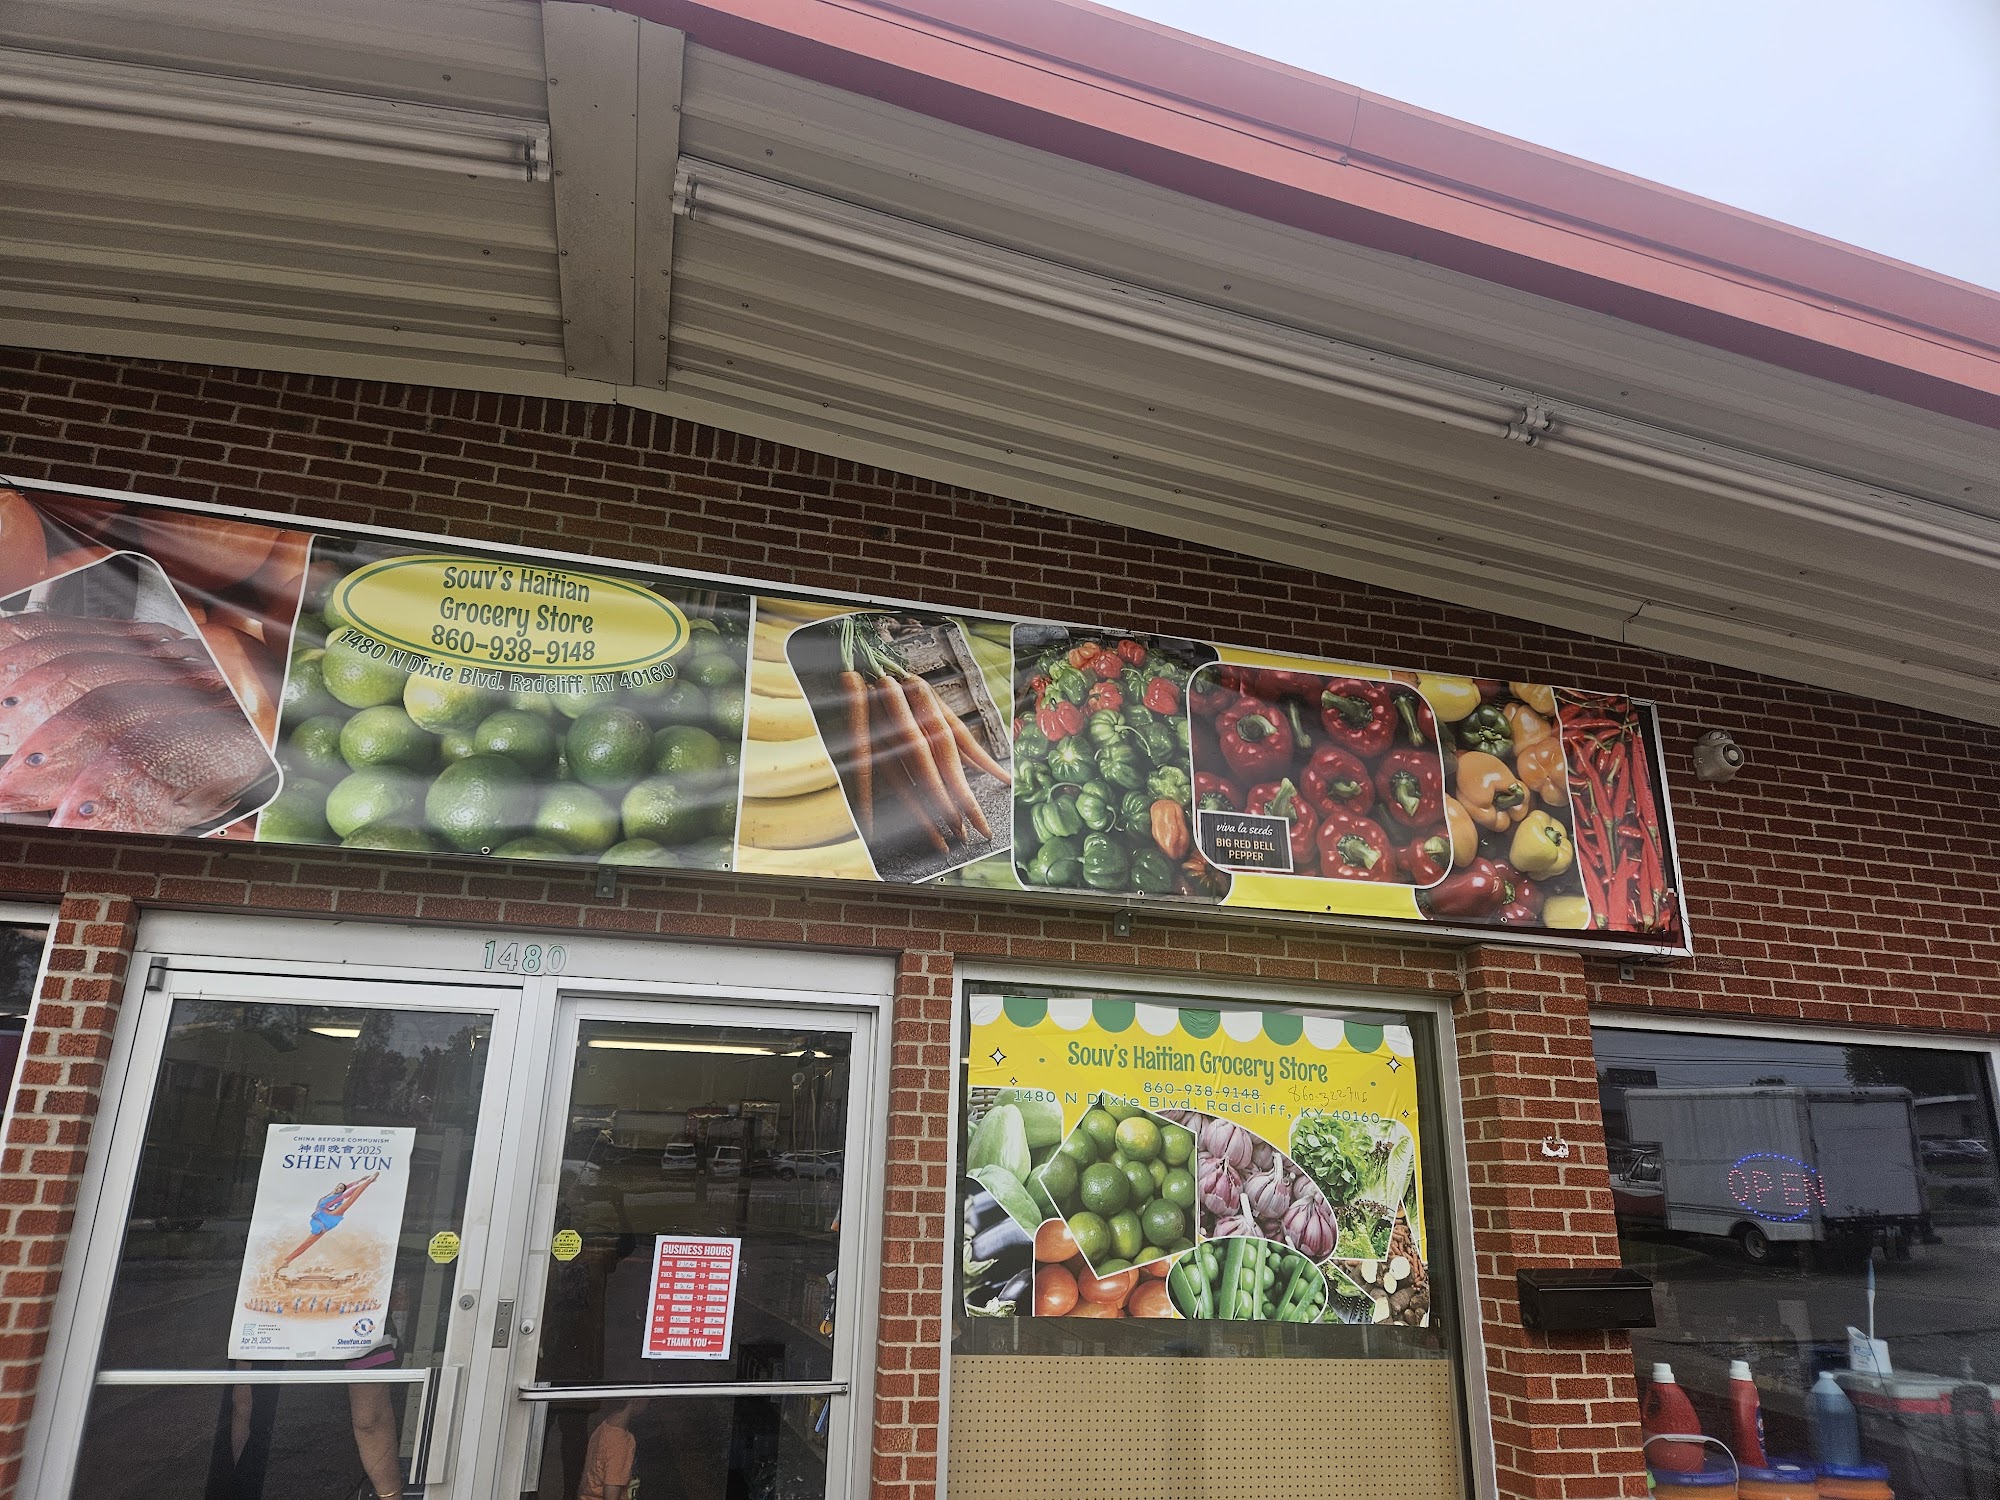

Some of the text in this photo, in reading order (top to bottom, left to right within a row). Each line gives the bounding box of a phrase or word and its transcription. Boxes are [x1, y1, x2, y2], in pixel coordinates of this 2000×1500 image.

[443, 566, 590, 603] Souv's Haitian
[440, 596, 594, 638] Grocery Store
[431, 624, 596, 664] 860-938-9148
[338, 628, 387, 660] 1480
[386, 648, 407, 669] N
[405, 654, 454, 682] Dixie
[458, 667, 504, 691] Blvd.
[591, 673, 616, 694] KY
[619, 661, 676, 690] 40160
[1216, 821, 1274, 836] viva la seeds
[1216, 837, 1275, 852] BIG RED BELL
[1228, 850, 1264, 861] PEPPER
[485, 940, 566, 974] 1480
[1068, 1041, 1328, 1086] Souv's Haitian Grocery Store
[1143, 1082, 1260, 1100] 860-938-9148
[1014, 1089, 1380, 1124] 1480 N Dixie Blvd. Radcliff, KY 40160
[356, 1145, 382, 1155] 2025
[282, 1154, 393, 1171] SHEN YUN
[1728, 1169, 1827, 1207] OPEN
[662, 1244, 732, 1256] BUSINESS HOURS
[241, 1336, 250, 1344] Apr
[259, 1336, 272, 1344] 2025
[666, 1338, 708, 1347] THANK YOU
